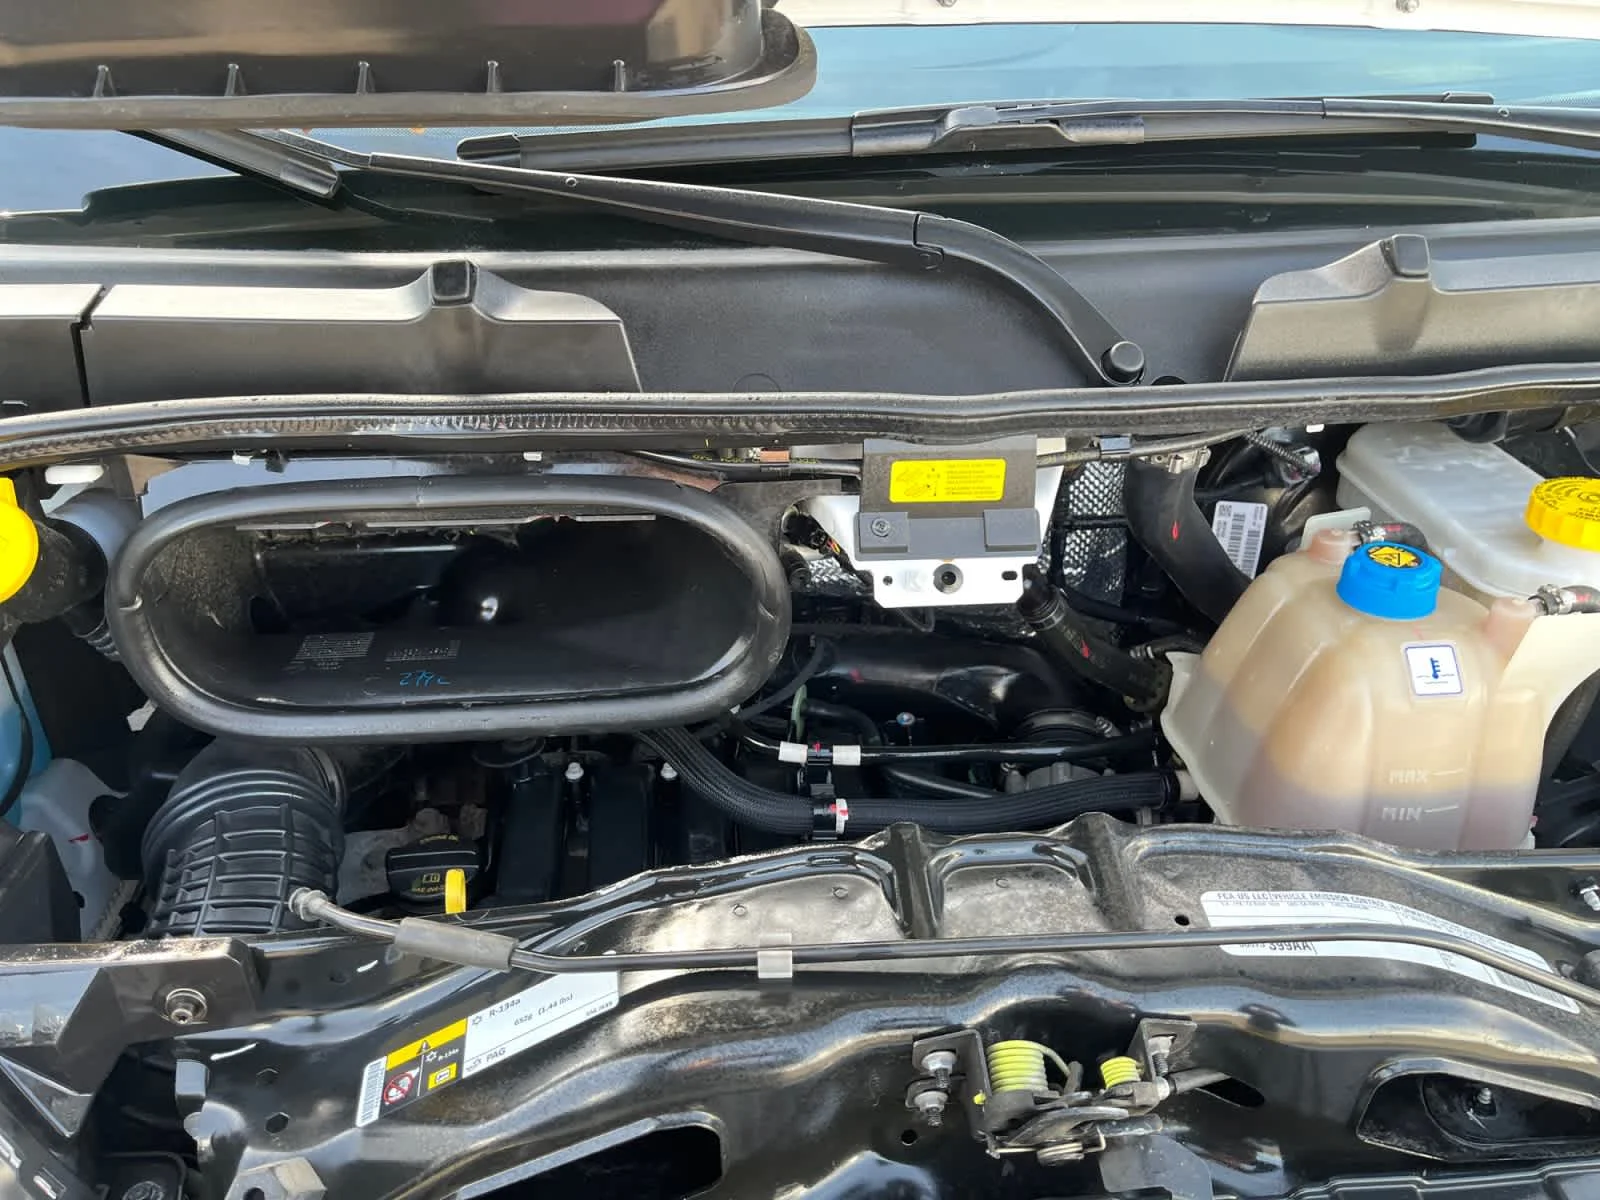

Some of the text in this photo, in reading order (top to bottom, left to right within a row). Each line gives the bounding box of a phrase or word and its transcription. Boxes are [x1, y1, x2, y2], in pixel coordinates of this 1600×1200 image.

[1388, 768, 1428, 784] MAX
[1382, 807, 1422, 821] MIN
[489, 998, 521, 1018] R-134a
[486, 1046, 507, 1063] PAG
